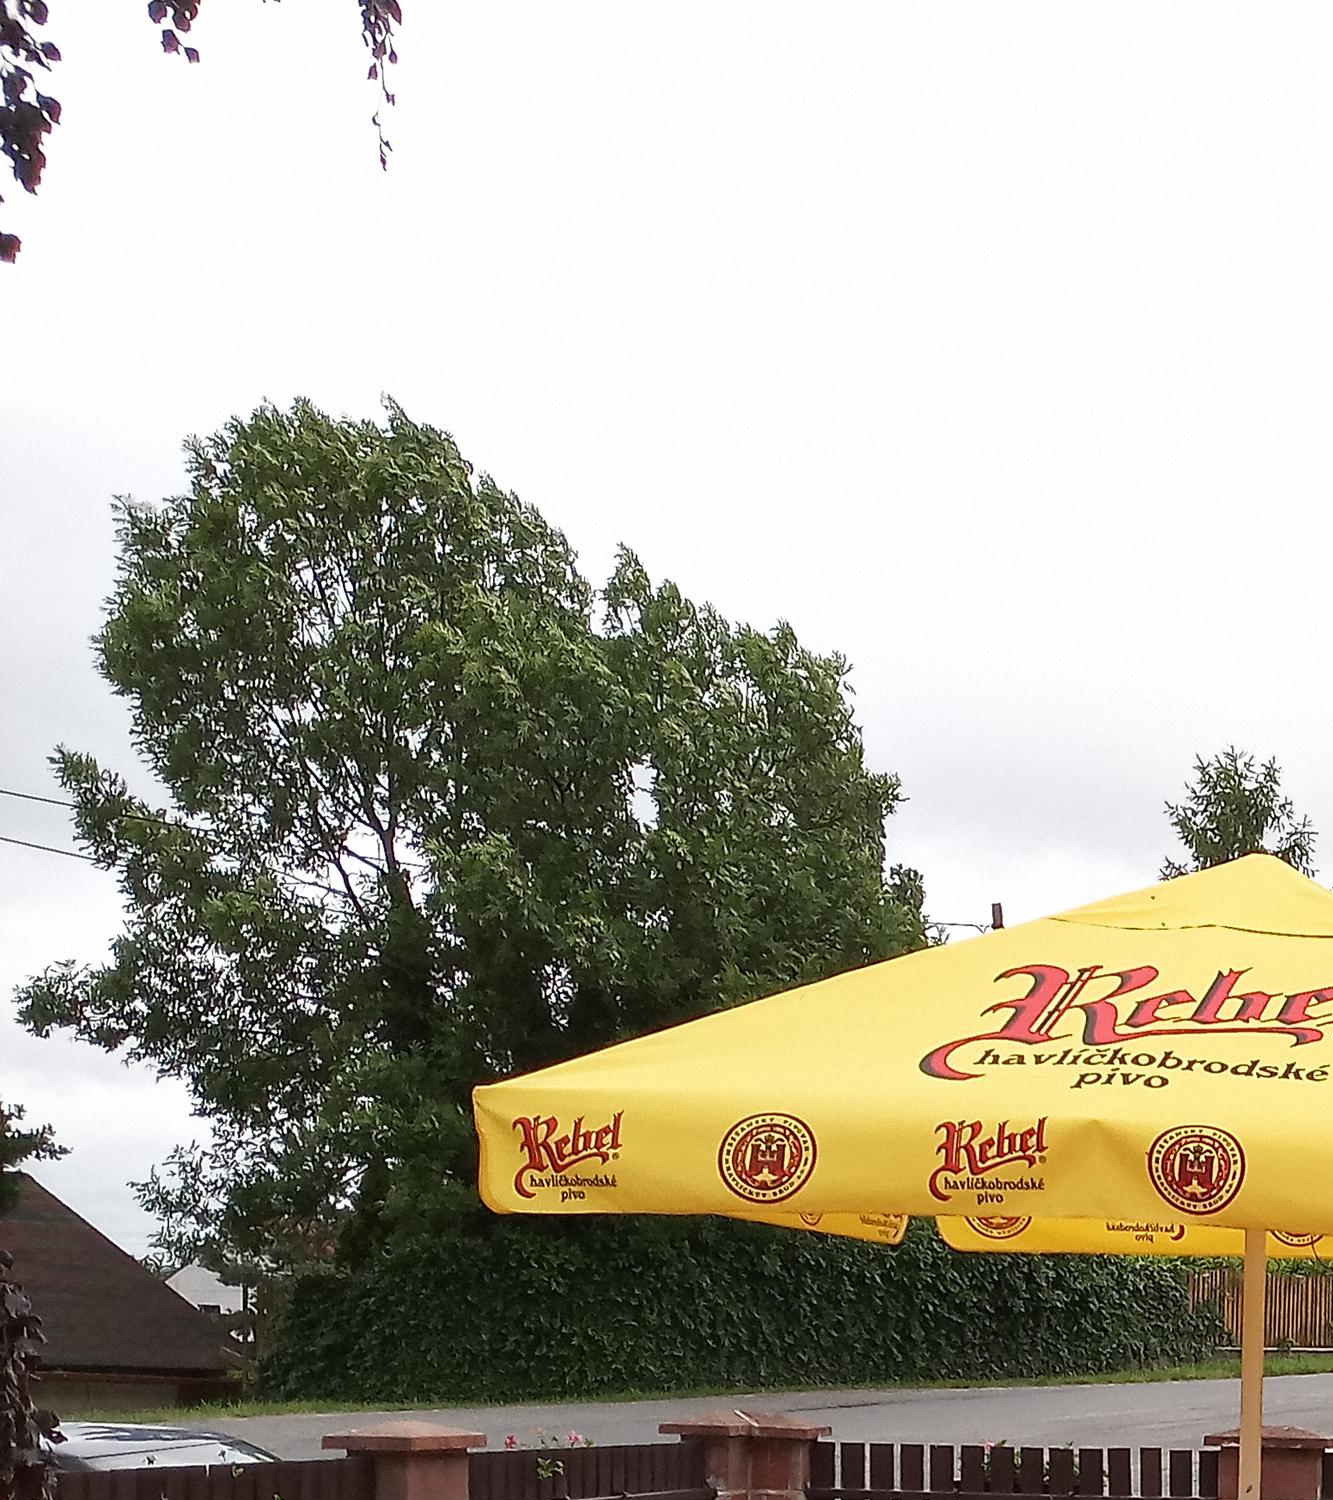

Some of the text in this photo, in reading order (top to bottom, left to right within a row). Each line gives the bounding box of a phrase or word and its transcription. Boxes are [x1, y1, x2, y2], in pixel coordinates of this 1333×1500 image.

[973, 1048, 1331, 1083] havlíčkobrodské
[1070, 1067, 1170, 1089] pivo
[512, 1108, 625, 1199] Rebel
[928, 1116, 1049, 1201] Rebel
[944, 1176, 1046, 1191] havlíčkobrodské
[561, 1188, 586, 1203] pivo
[976, 1191, 1004, 1206] pivo
